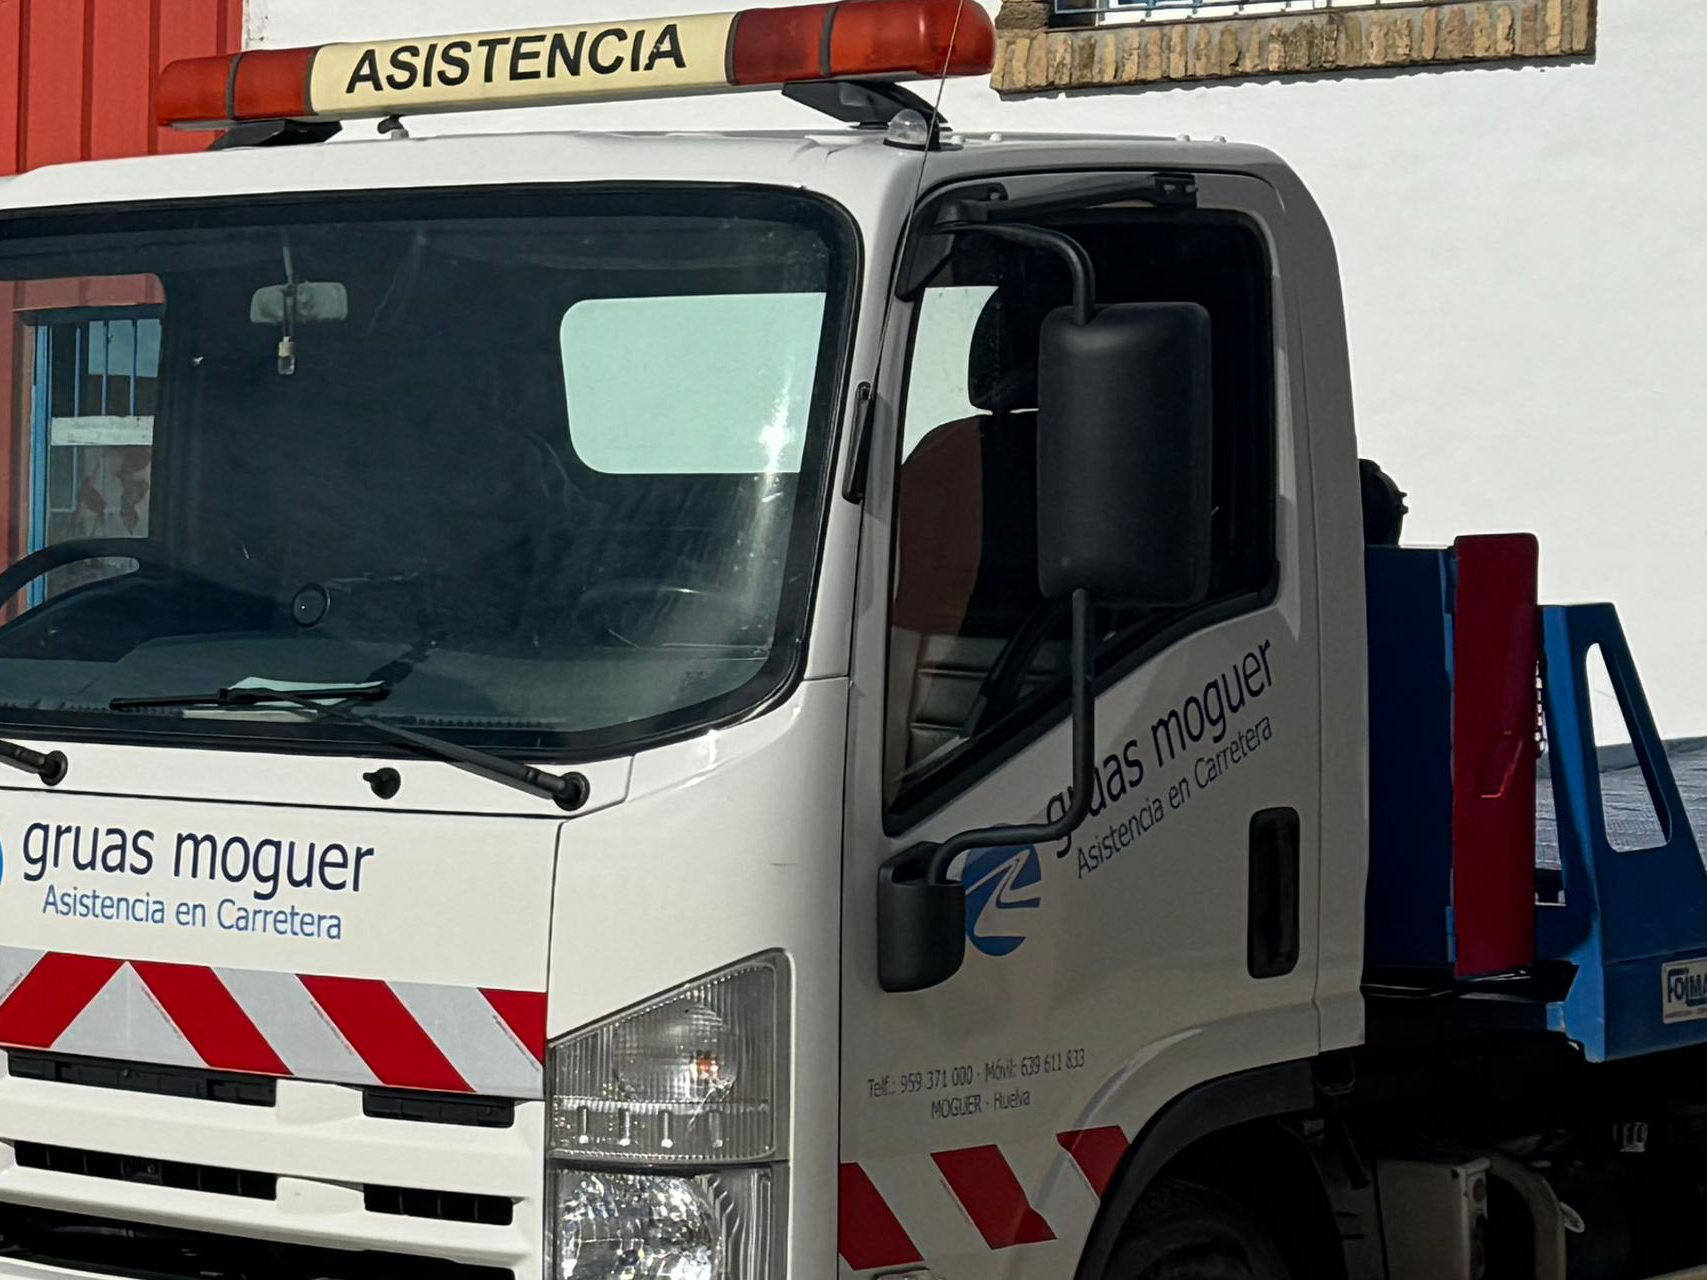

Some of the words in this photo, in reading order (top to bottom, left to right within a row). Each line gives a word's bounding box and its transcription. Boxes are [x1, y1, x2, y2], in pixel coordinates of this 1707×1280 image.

[346, 23, 687, 94] ASISTENCIA
[1046, 739, 1144, 859] guas
[1150, 639, 1272, 768] moguer
[1077, 796, 1165, 879] Asistencia
[1168, 777, 1192, 810] en
[1193, 716, 1273, 789] Carretera
[22, 822, 155, 882] gruas
[173, 831, 375, 901] moguer
[42, 884, 165, 924] Asistencia
[175, 900, 206, 927] en
[217, 898, 342, 940] Carretera
[900, 1072, 923, 1094] 959
[927, 1068, 948, 1090] 371
[930, 1094, 983, 1120] MOGUER
[993, 1088, 1031, 1111] Huelva
